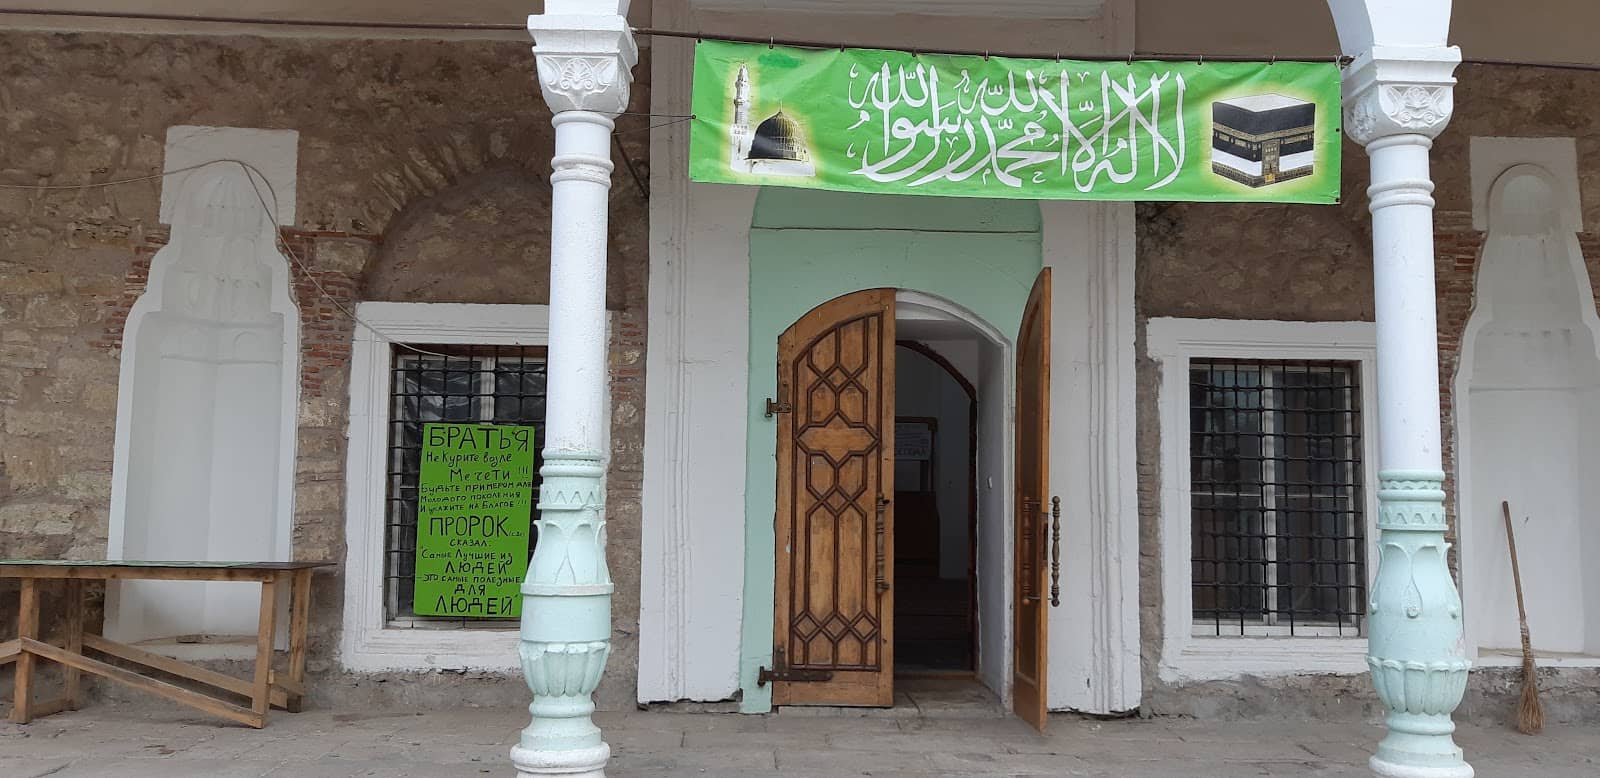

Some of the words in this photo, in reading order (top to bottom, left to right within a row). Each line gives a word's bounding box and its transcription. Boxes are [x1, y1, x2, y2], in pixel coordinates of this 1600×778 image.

[430, 515, 509, 538] ПРОРОК
[445, 560, 507, 575] ЛЮДЕЙ
[454, 583, 486, 597] ДЛЯ
